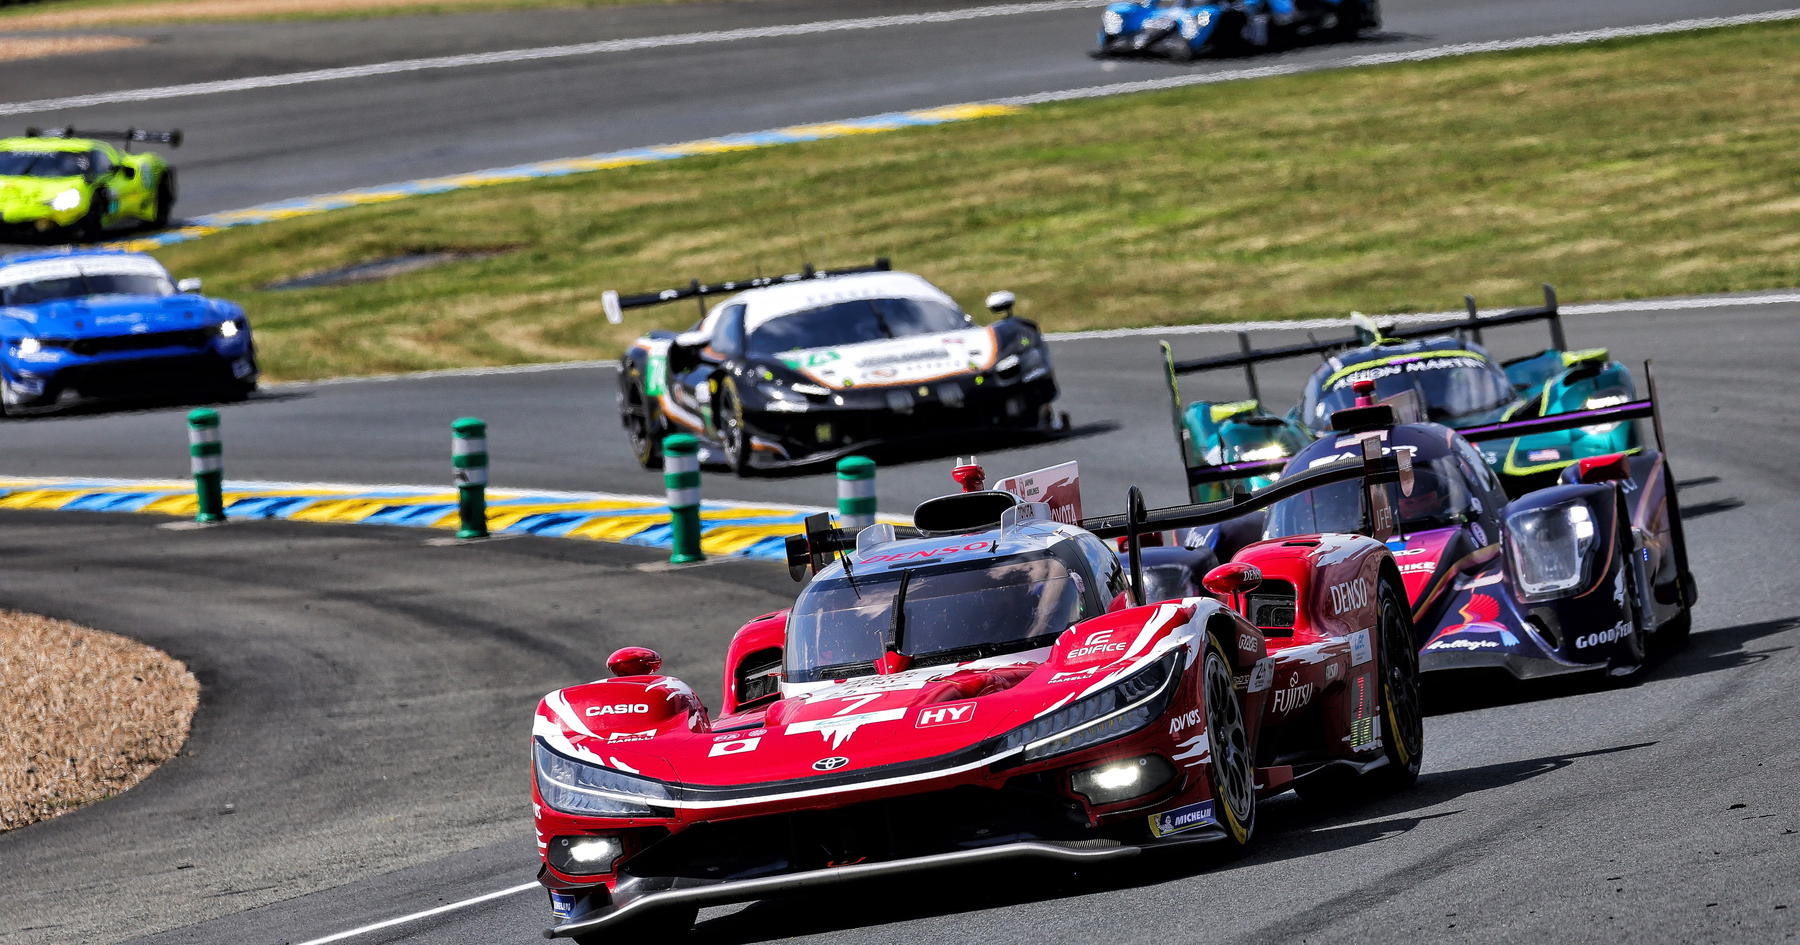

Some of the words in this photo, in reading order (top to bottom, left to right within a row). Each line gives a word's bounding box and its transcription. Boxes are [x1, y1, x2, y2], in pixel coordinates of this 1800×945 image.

[1051, 503, 1078, 526] OYOTA
[859, 541, 989, 565] DENSO
[1243, 570, 1260, 581] DENS
[1400, 561, 1436, 572] RIKE
[1330, 577, 1367, 615] DENSO
[1576, 620, 1632, 649] GOODYEA
[1066, 642, 1127, 659] EDIFICE
[832, 692, 884, 717] 7
[1271, 682, 1313, 717] FUJITSU
[585, 703, 649, 717] CASIO
[920, 705, 971, 725] HY
[607, 736, 654, 745] MARELLI
[1174, 807, 1212, 826] MICHELIN
